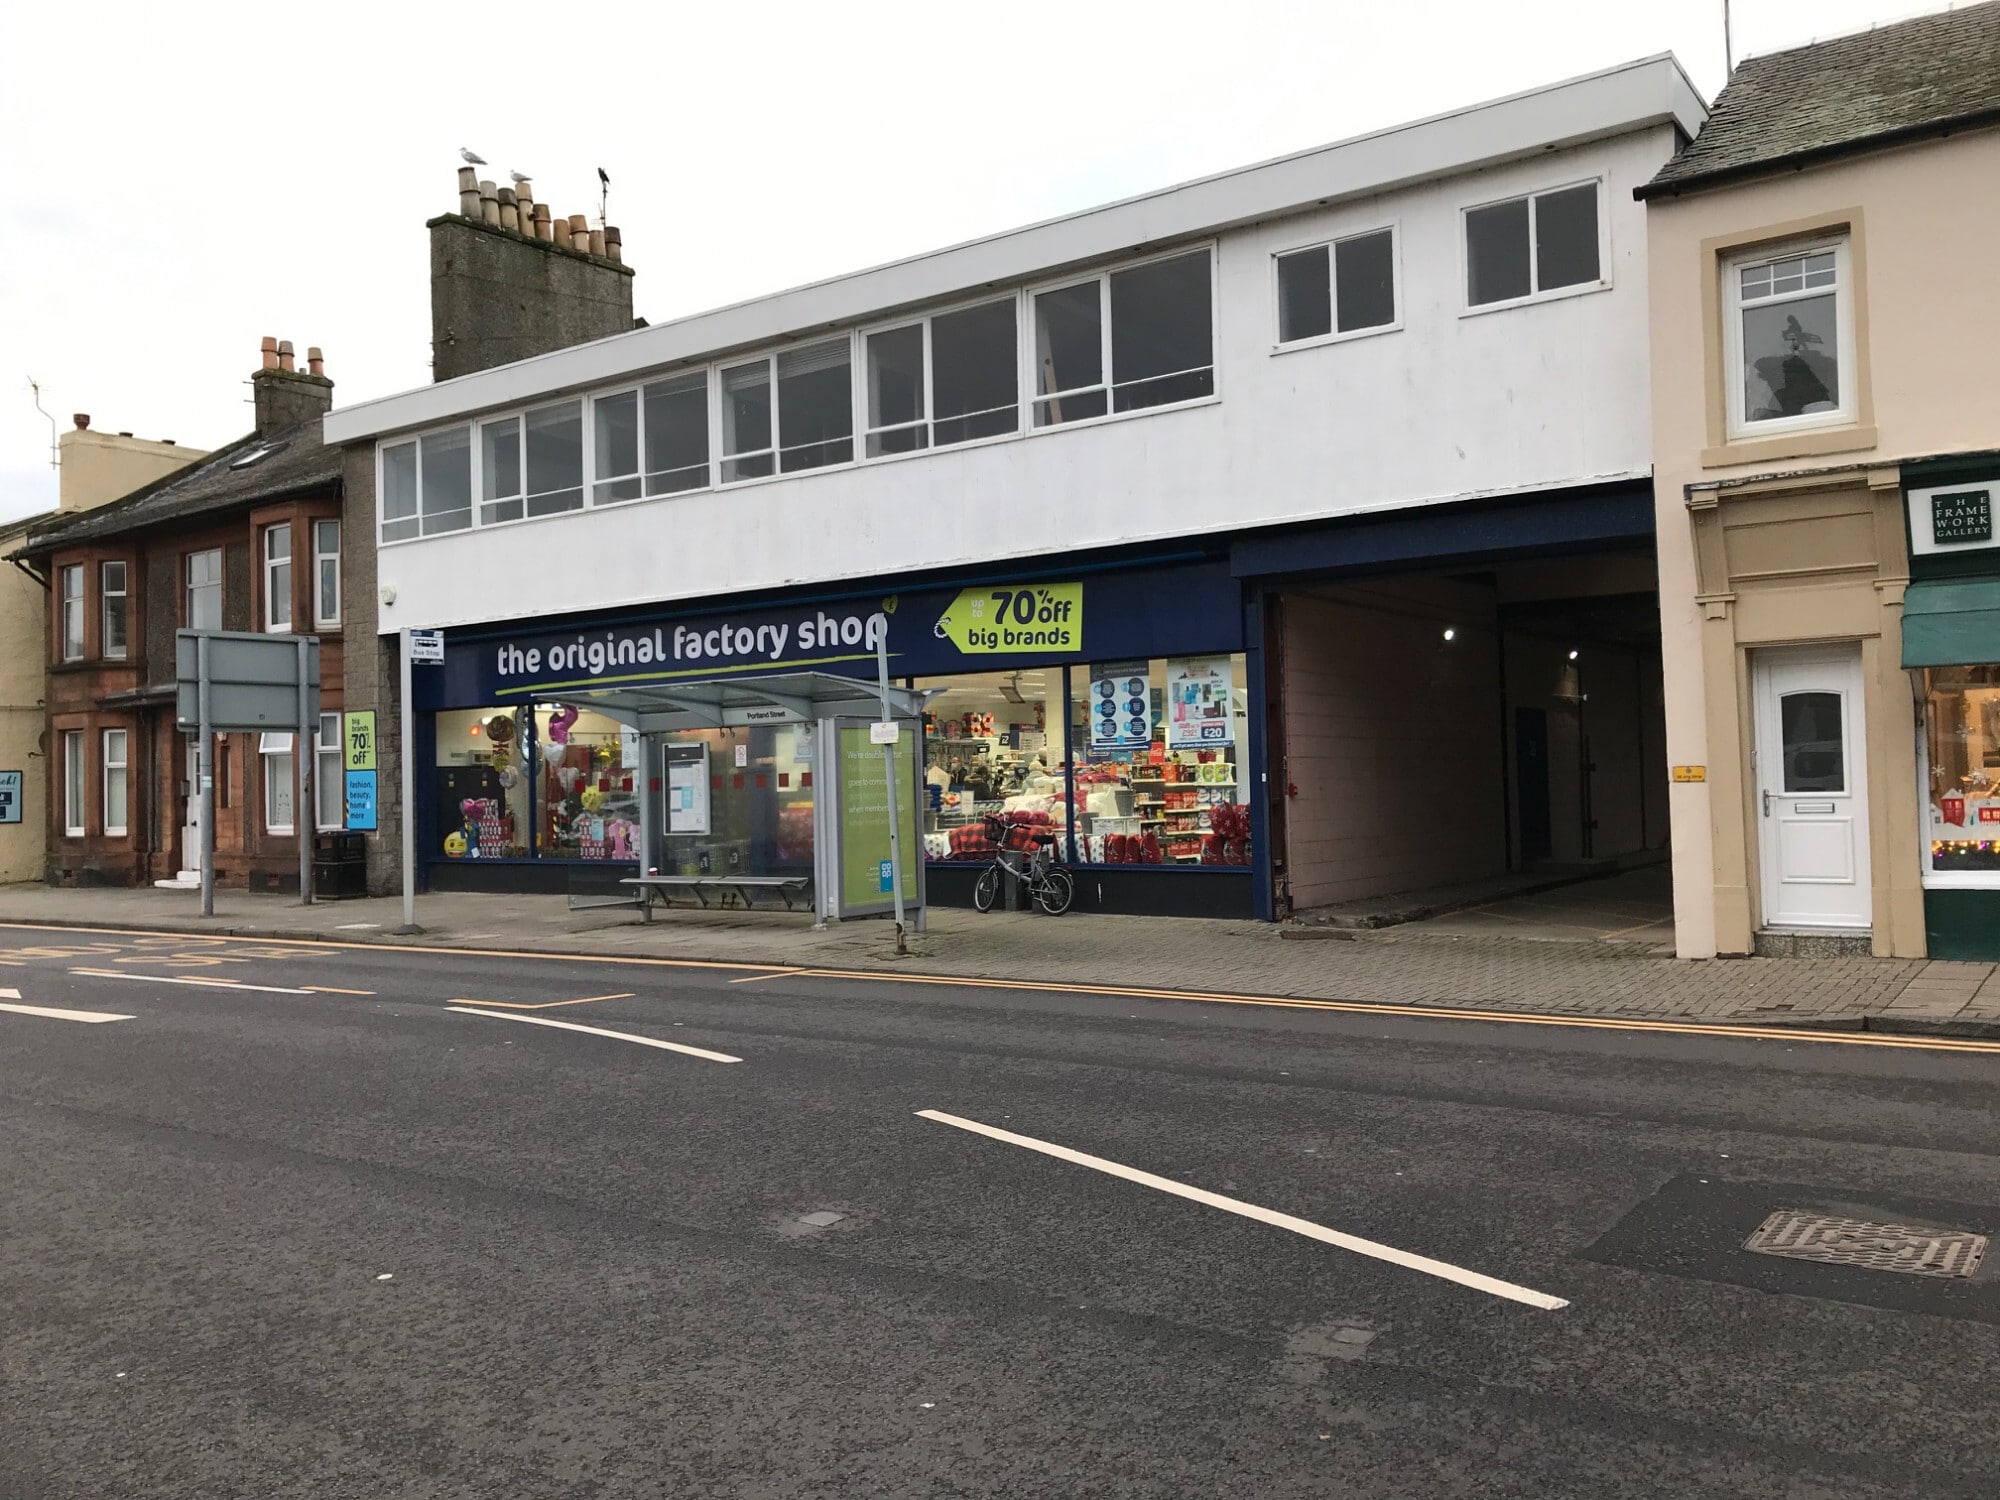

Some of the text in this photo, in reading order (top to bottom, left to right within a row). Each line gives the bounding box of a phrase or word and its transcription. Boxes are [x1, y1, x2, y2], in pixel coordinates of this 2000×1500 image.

[1936, 506, 1988, 518] FRAME
[1936, 526, 1989, 538] GALLERY
[971, 600, 985, 609] up
[972, 609, 983, 618] to
[1037, 600, 1072, 623] off
[968, 626, 1071, 650] big brands
[498, 611, 888, 676] the original factory shop
[746, 711, 770, 720] Portland
[351, 724, 369, 733] brands
[1204, 728, 1223, 738] £20
[352, 750, 367, 765] off
[349, 801, 366, 810] home
[349, 812, 365, 820] more
